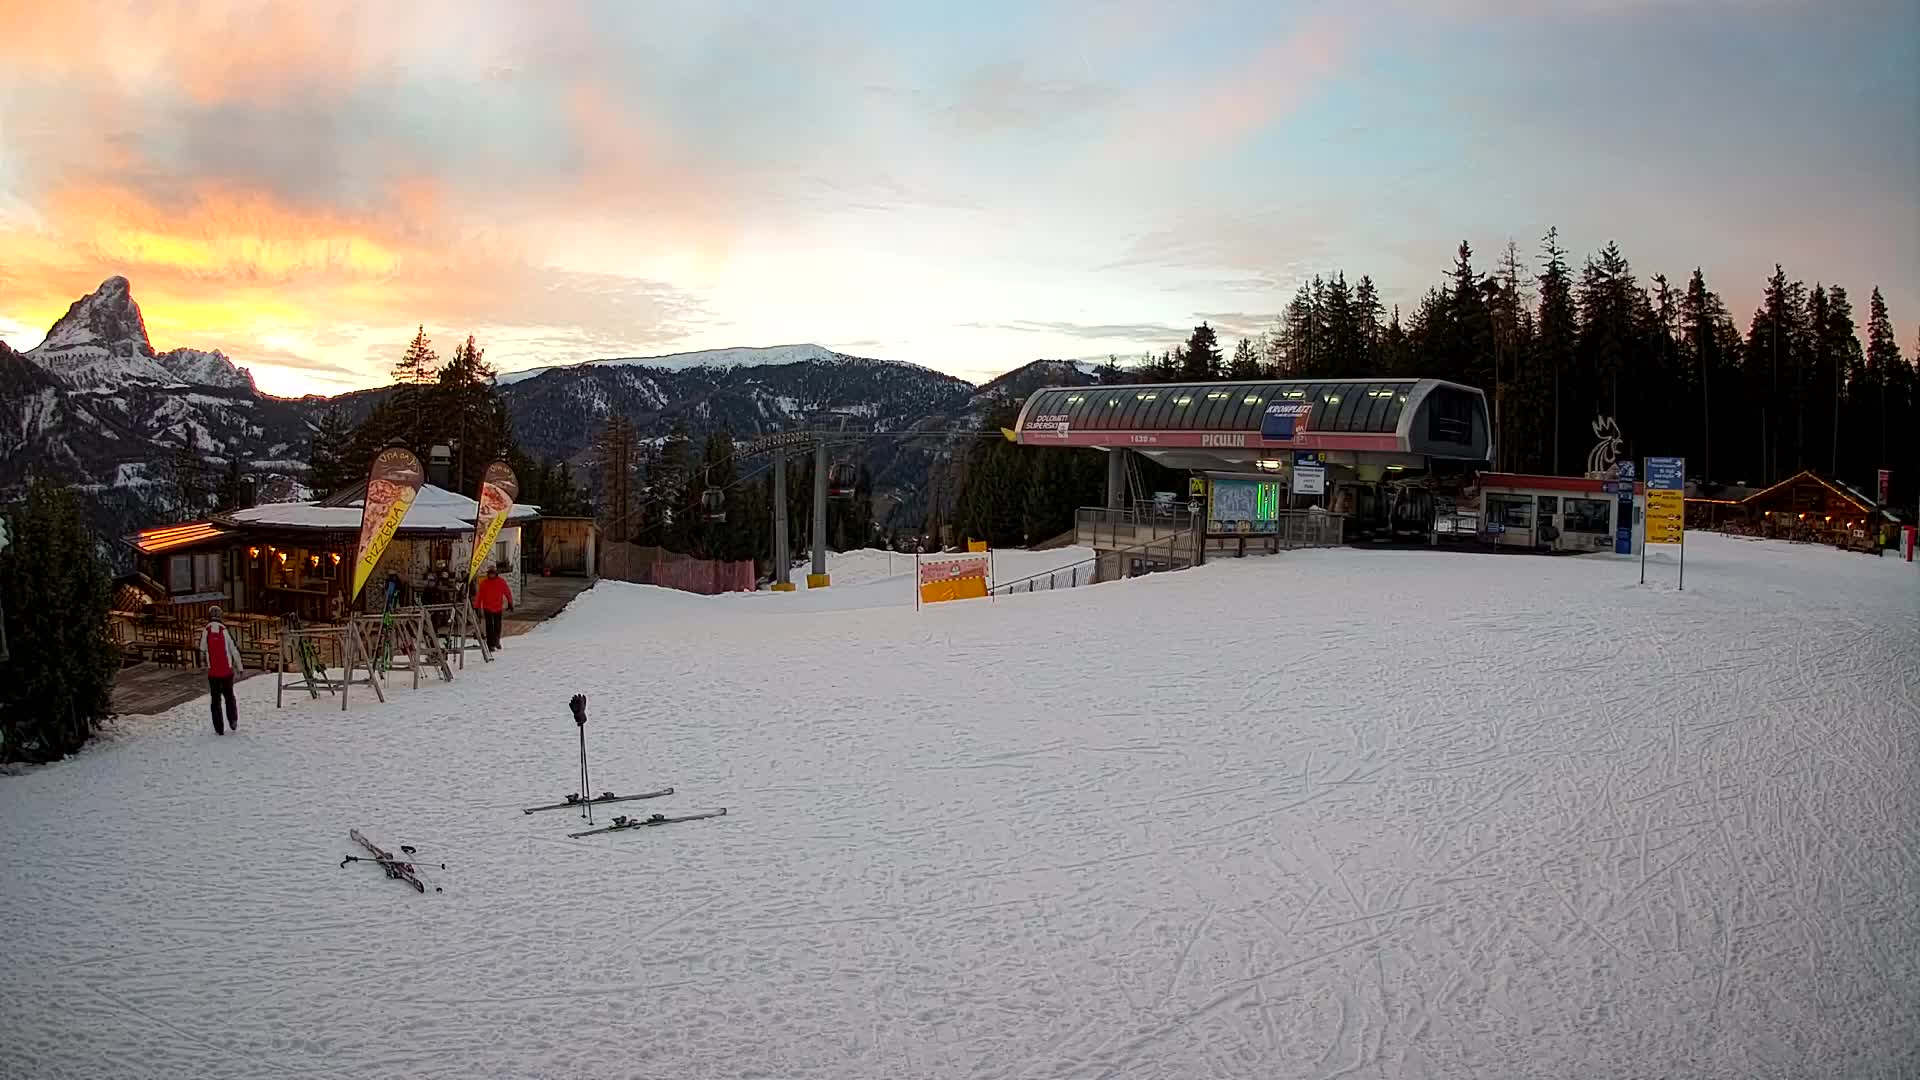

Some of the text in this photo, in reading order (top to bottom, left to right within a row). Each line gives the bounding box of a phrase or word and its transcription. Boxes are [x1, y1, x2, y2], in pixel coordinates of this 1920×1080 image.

[1266, 405, 1312, 413] KRONPLATZ
[1036, 414, 1068, 422] DOLOMITI
[1202, 434, 1245, 447] PICULIN
[364, 507, 404, 565] PIZZERIA
